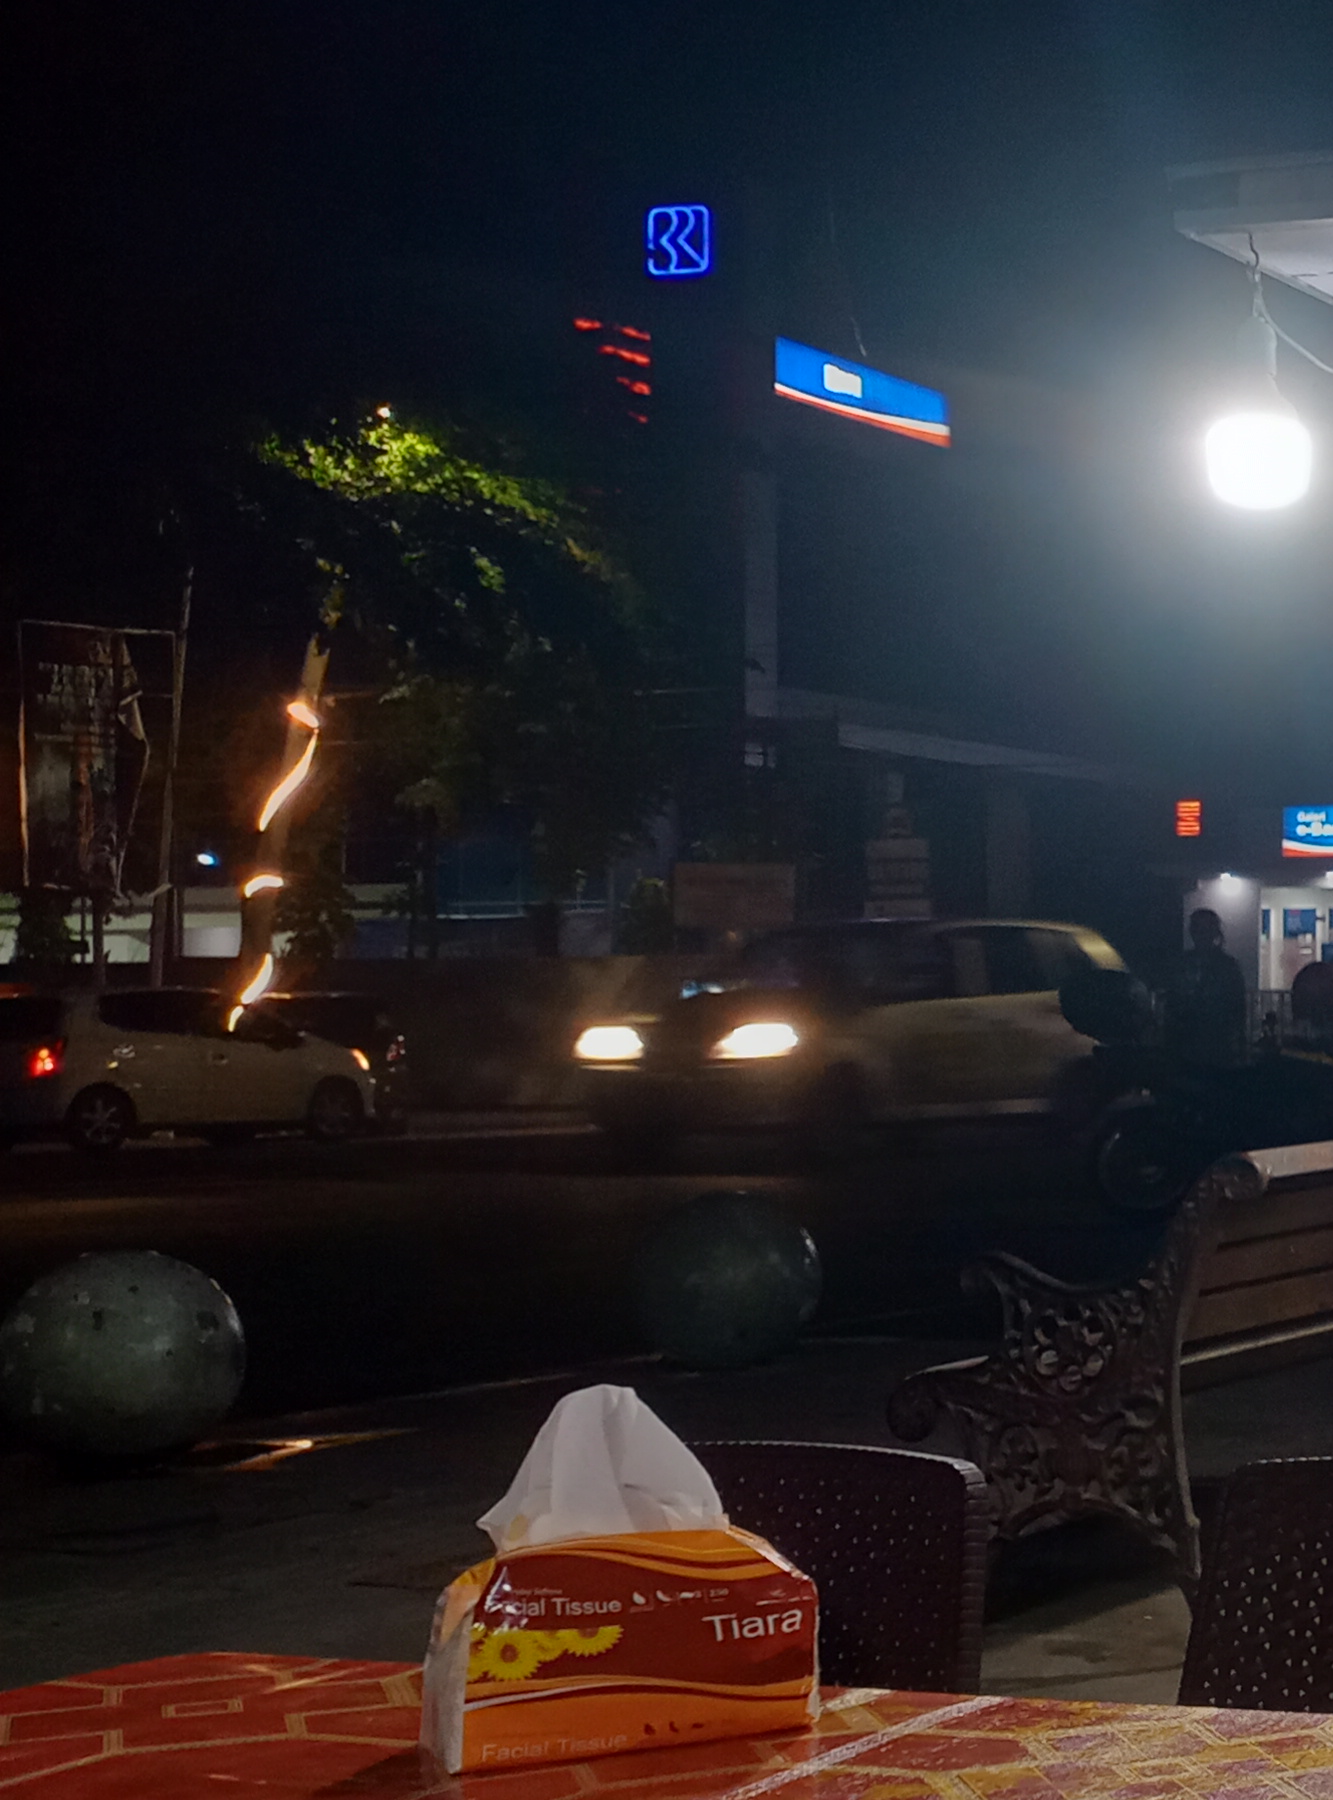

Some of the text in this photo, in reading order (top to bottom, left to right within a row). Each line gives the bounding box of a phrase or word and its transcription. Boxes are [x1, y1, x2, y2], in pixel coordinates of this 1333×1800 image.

[502, 1597, 622, 1617] cial Tissue
[701, 1608, 803, 1642] Tiara
[481, 1732, 628, 1762] Facial Tissue
